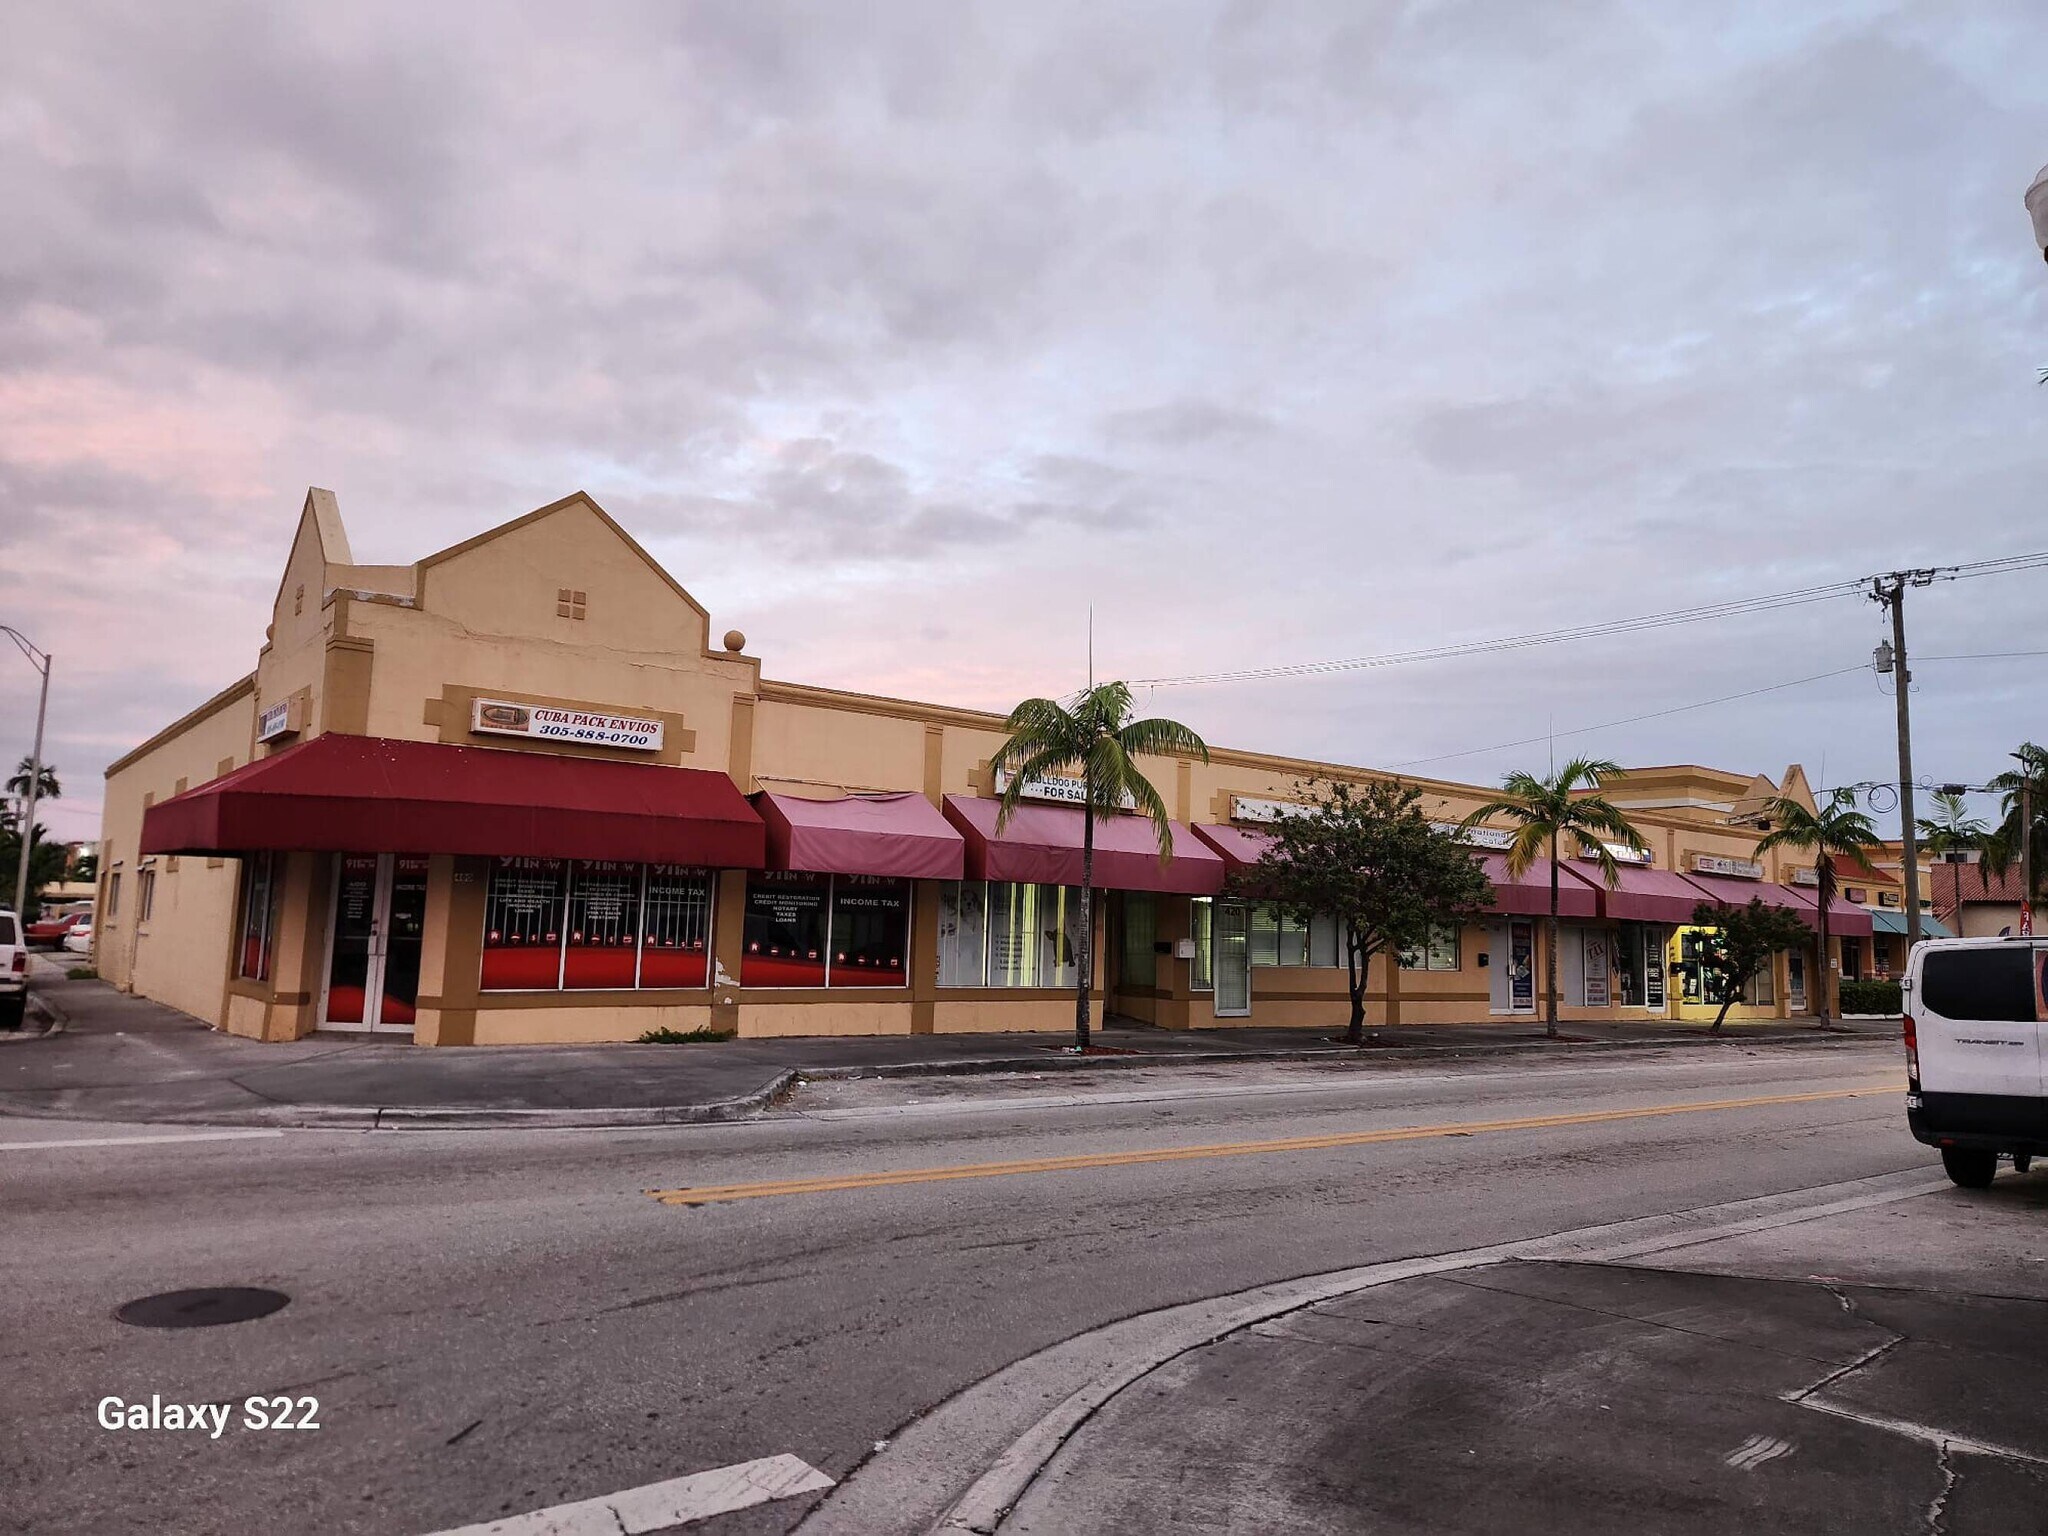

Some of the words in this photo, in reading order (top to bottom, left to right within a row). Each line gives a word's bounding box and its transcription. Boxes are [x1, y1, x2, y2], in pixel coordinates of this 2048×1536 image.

[534, 709, 570, 724] CUBA
[571, 714, 607, 728] PACK
[608, 719, 659, 734] ENVIOS
[539, 725, 648, 745] 305-888-0700
[1066, 789, 1088, 802] SAL
[649, 886, 685, 895] INCOME
[688, 888, 705, 896] TAX
[840, 897, 879, 907] INCOME
[882, 899, 900, 908] TAX
[1225, 907, 1240, 916] 420
